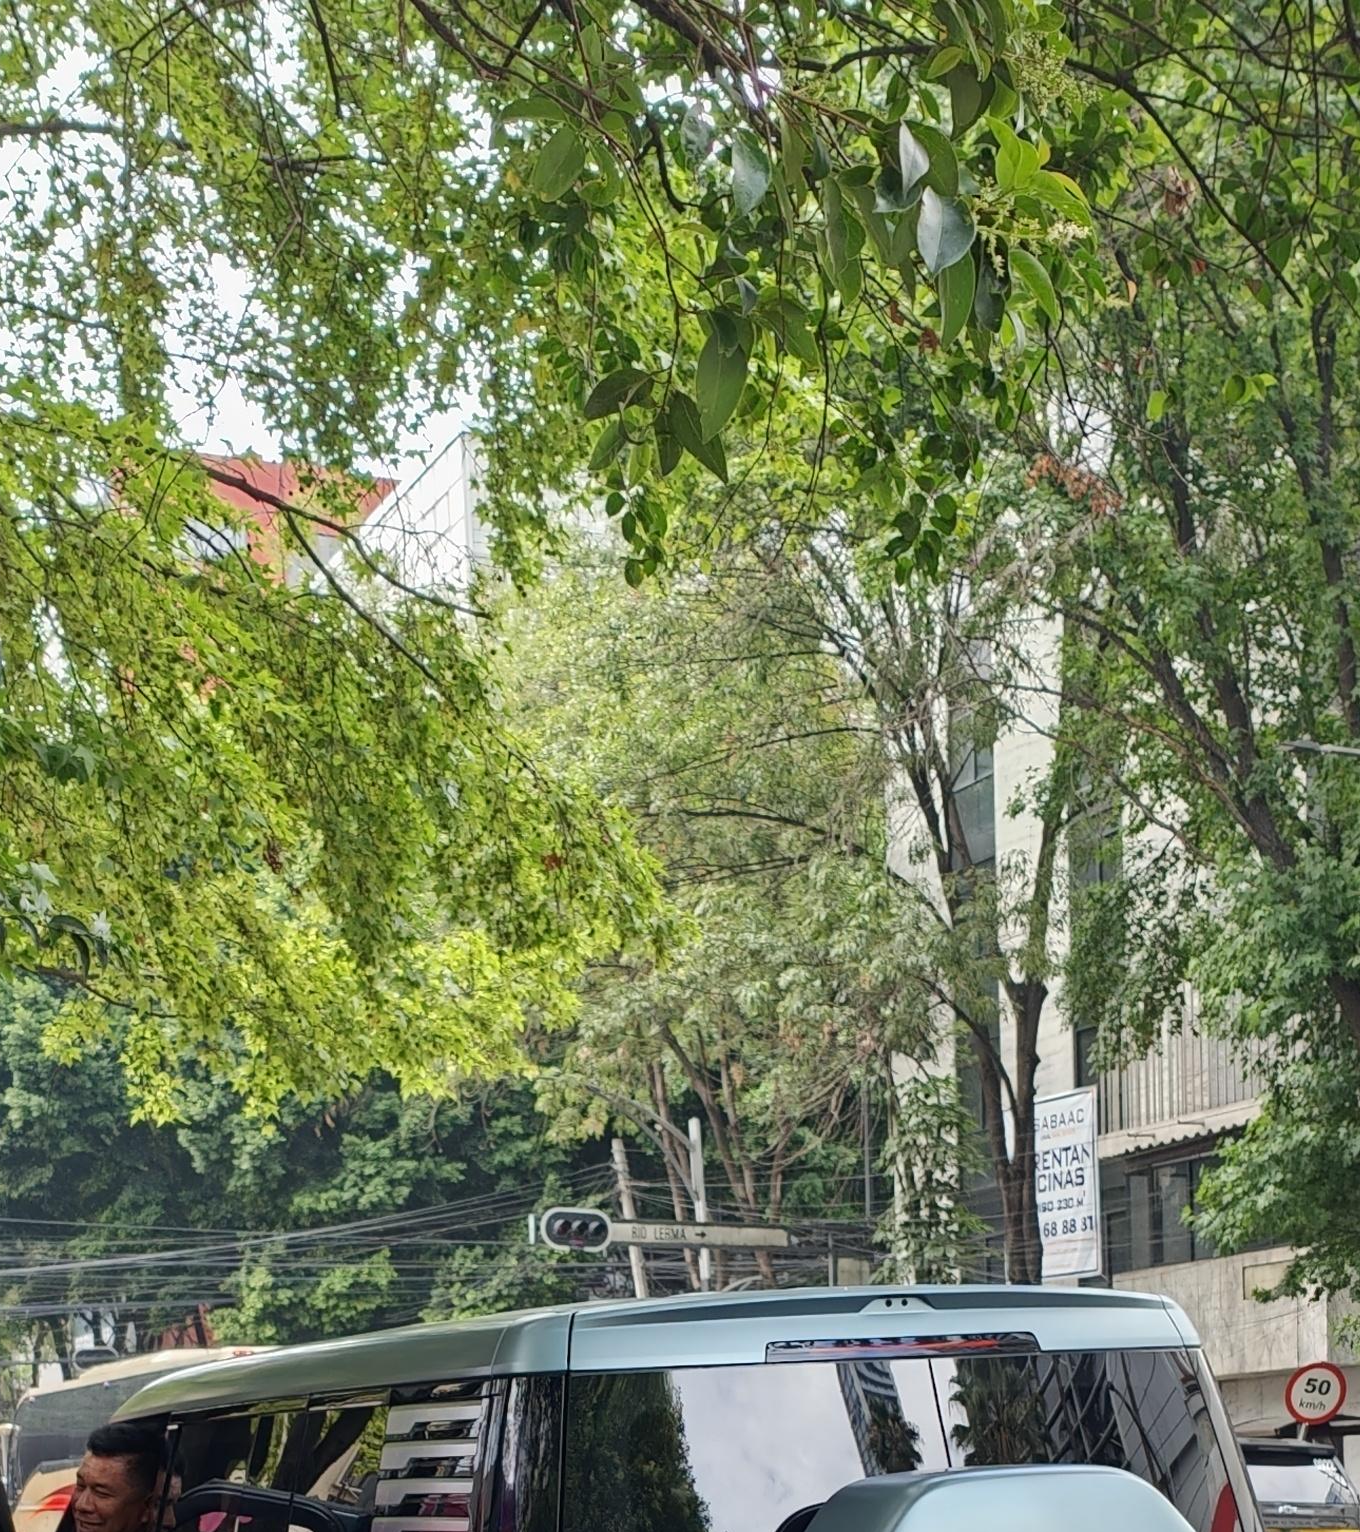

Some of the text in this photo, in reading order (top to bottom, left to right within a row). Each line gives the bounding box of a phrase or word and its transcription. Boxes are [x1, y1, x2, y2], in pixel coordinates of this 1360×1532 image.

[1037, 1166, 1085, 1193] CINAS
[654, 1227, 687, 1242] LERMA
[1304, 1377, 1331, 1396] 50
[1298, 1399, 1327, 1412] km/h
